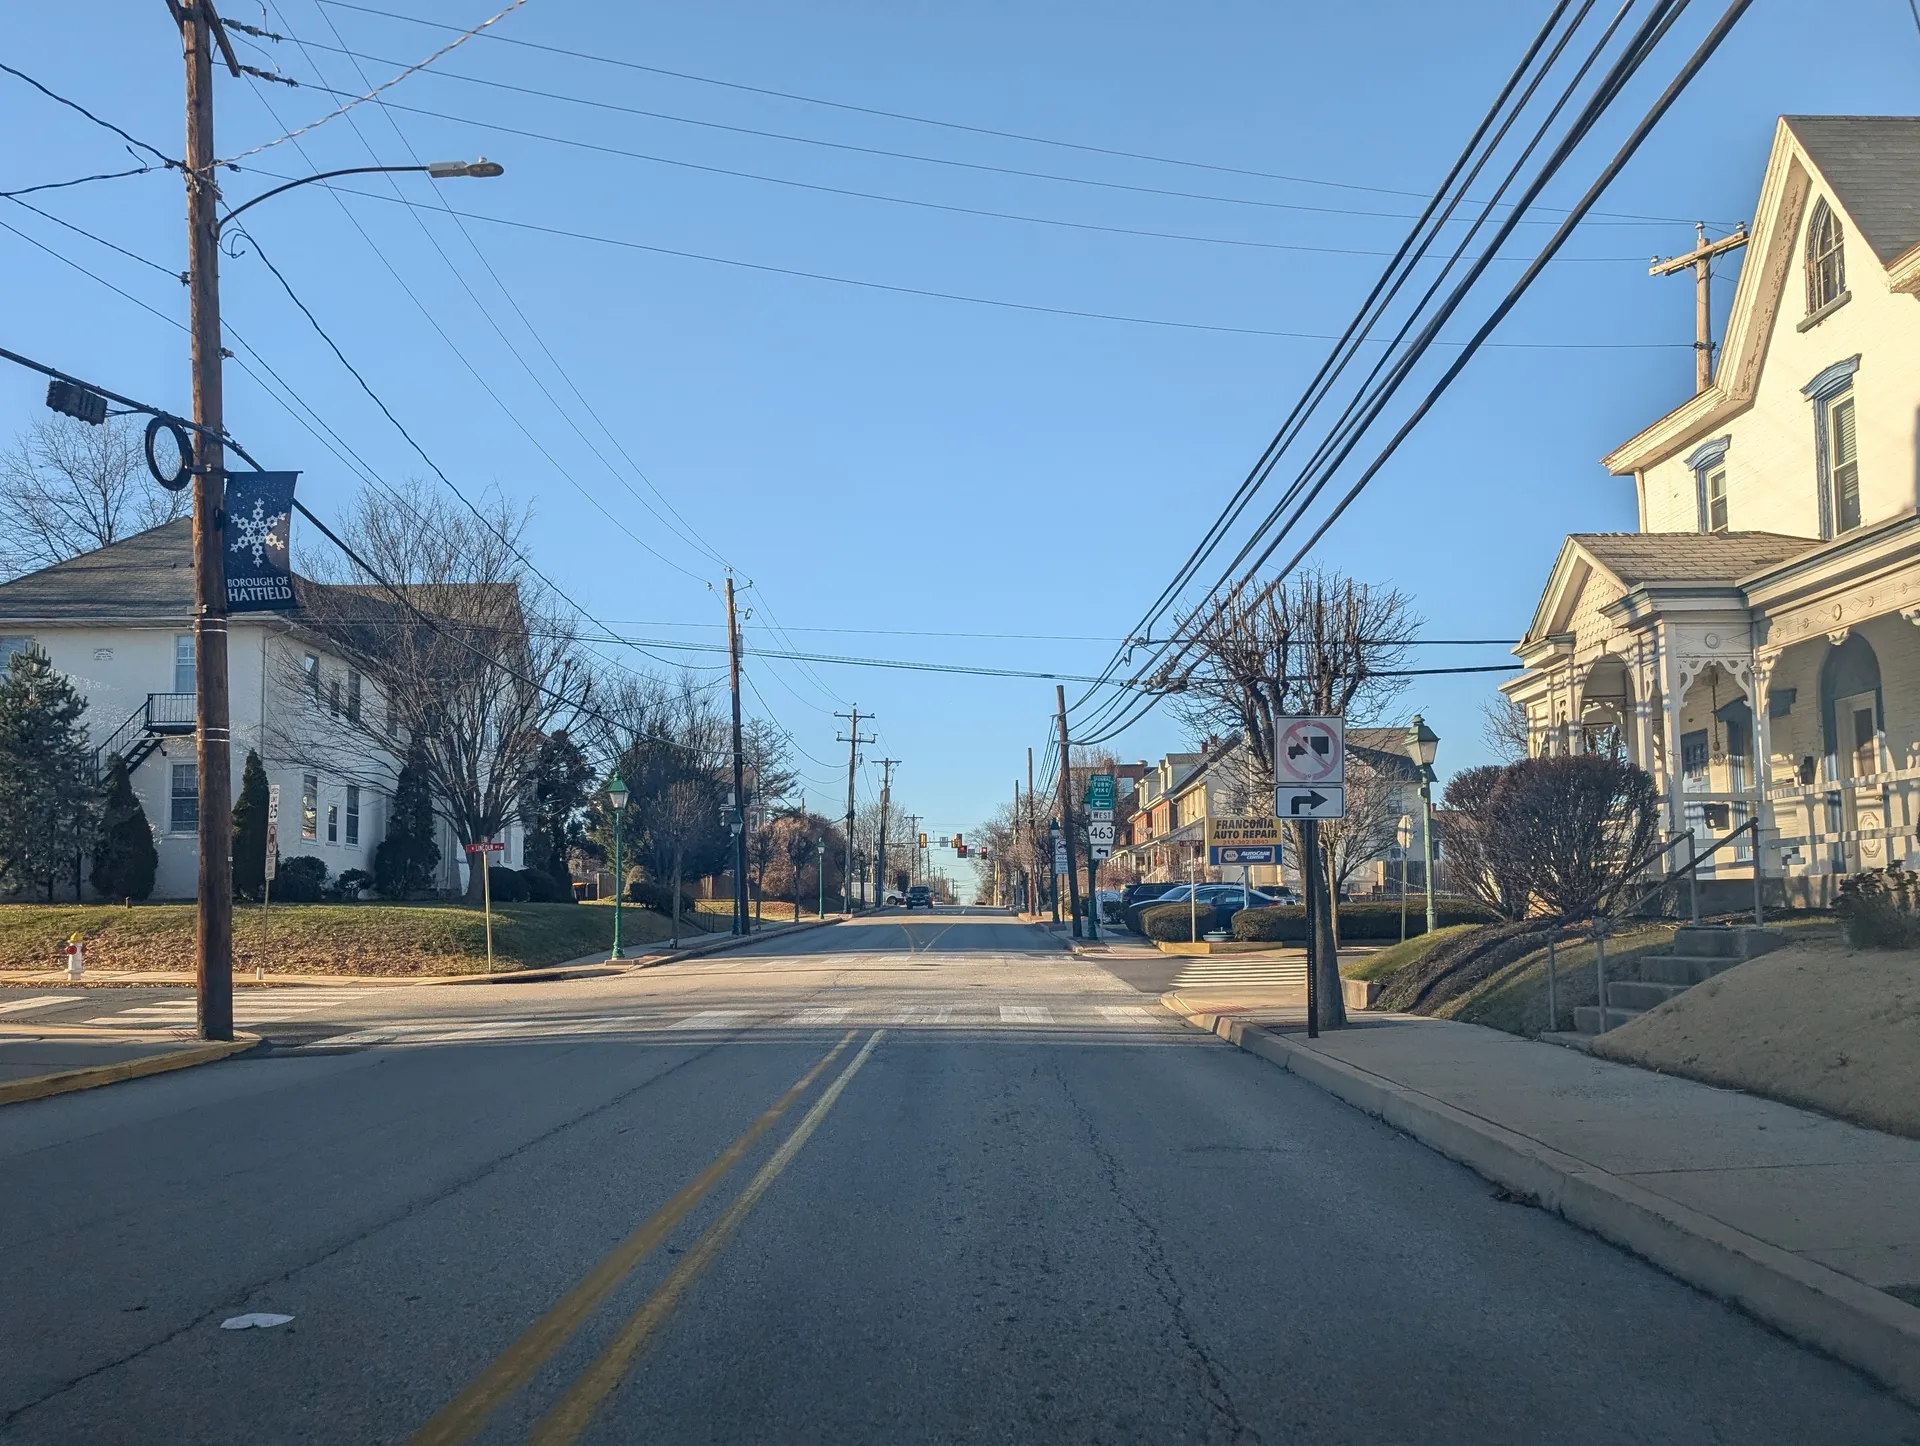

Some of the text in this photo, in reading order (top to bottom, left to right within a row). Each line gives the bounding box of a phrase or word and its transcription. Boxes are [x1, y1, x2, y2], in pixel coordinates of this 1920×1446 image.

[227, 576, 289, 587] BOROUGH OF
[228, 586, 292, 602] HATFIELD
[269, 804, 277, 818] 25
[1216, 819, 1274, 830] FRANCONIA
[1090, 827, 1114, 839] 463
[1213, 830, 1278, 839] AUTO REPAIR
